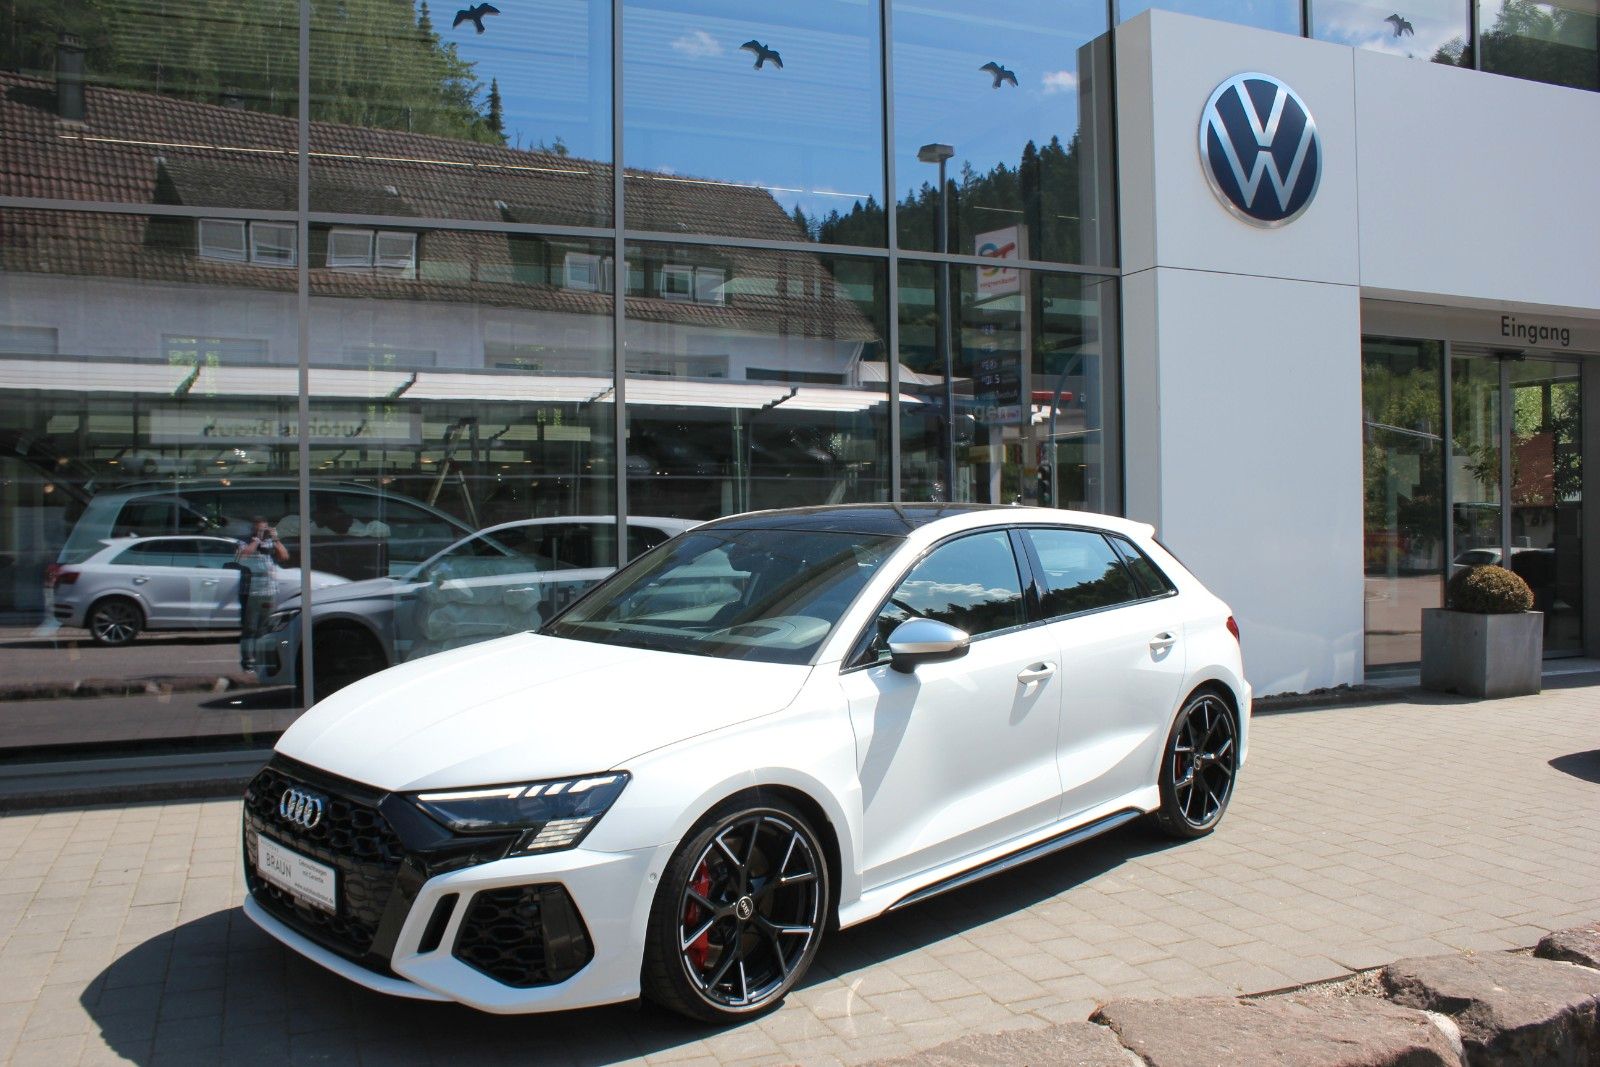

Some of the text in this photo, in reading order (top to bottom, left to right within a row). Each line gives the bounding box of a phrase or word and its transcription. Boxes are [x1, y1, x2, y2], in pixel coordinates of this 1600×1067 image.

[1206, 77, 1315, 214] VW
[1501, 316, 1570, 347] Eingang
[266, 852, 292, 879] BRAUN
